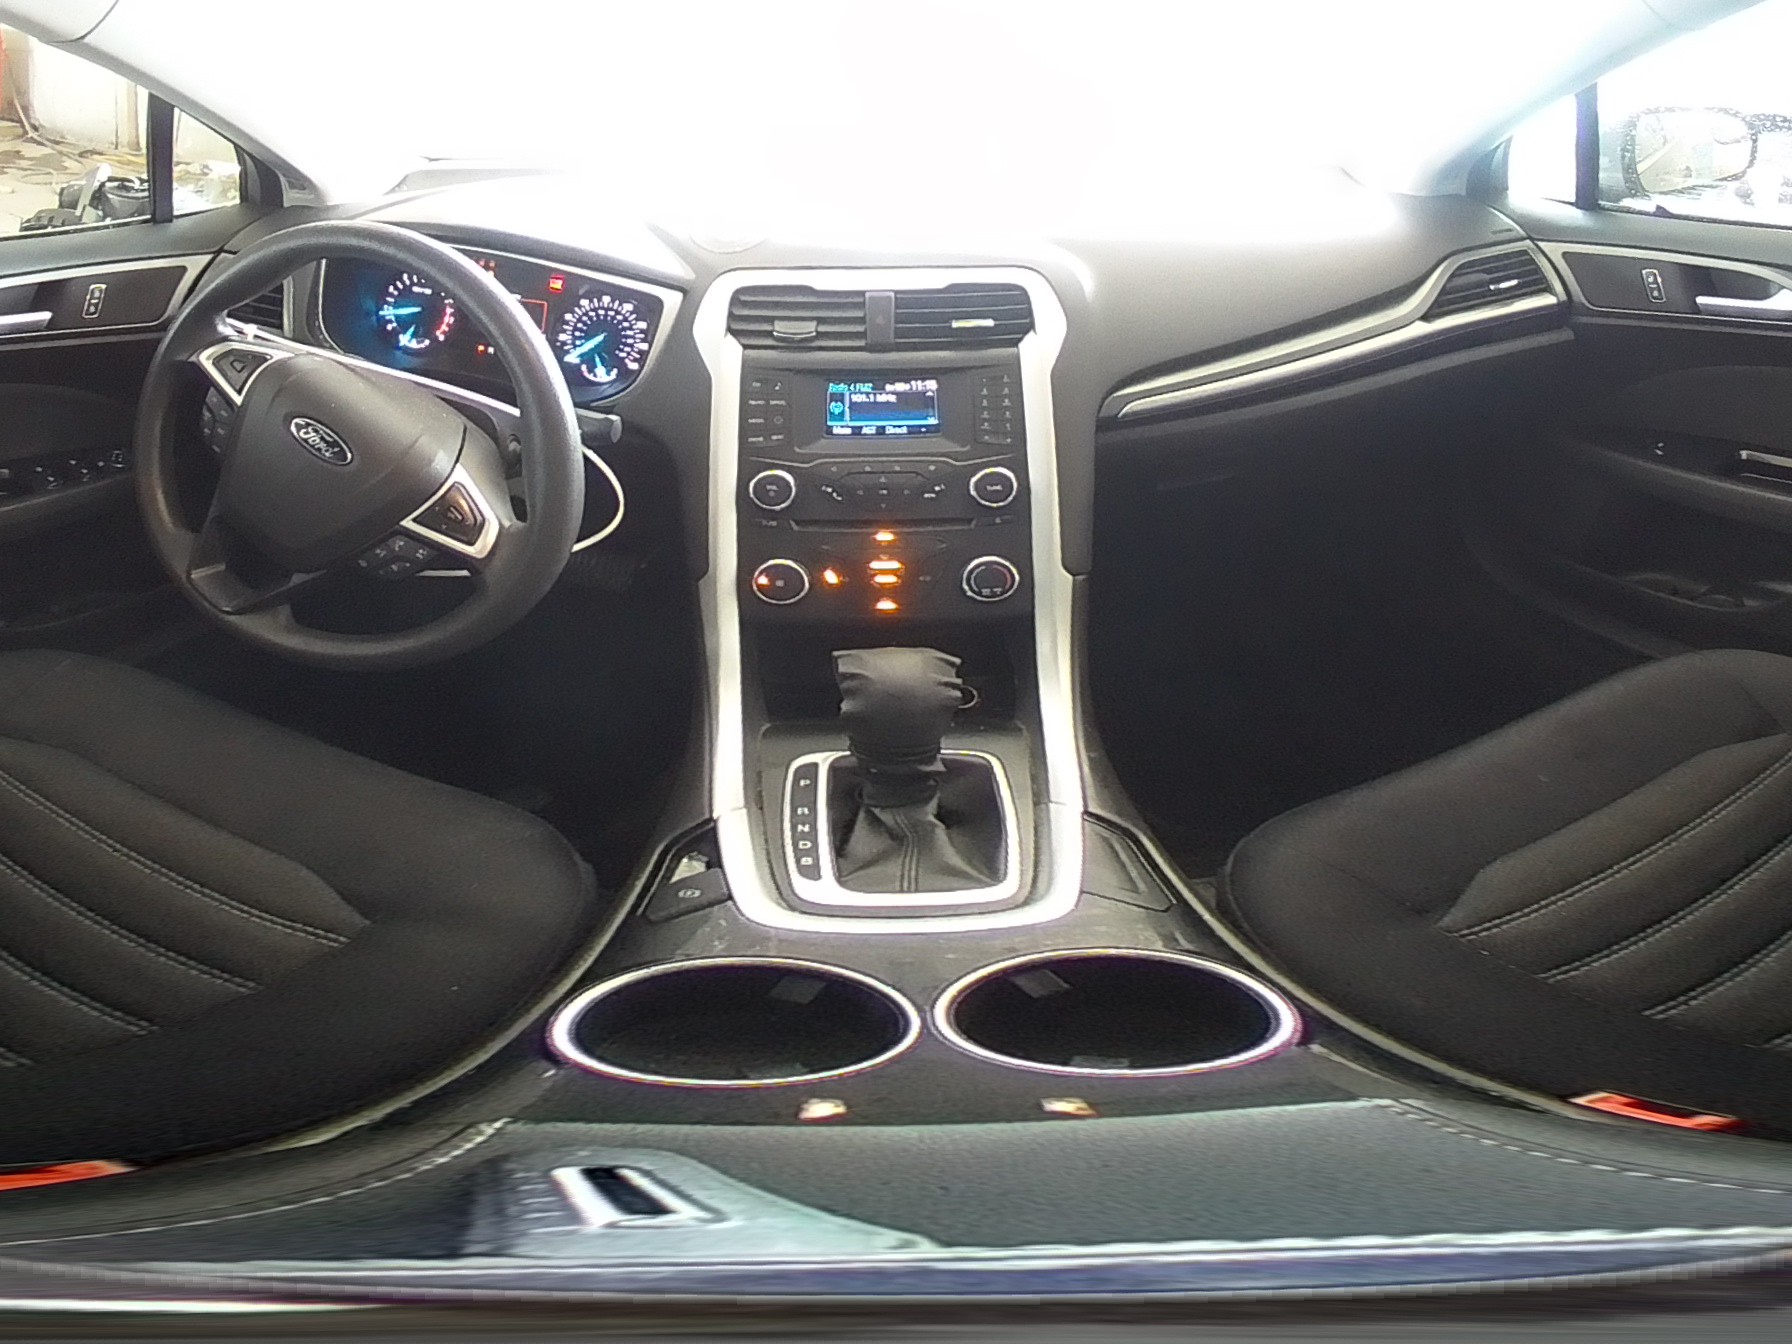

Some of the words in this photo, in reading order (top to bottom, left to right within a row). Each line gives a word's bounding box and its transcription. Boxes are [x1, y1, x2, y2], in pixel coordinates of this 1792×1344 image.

[799, 778, 811, 787] P
[797, 824, 810, 833] N
[798, 840, 812, 849] D
